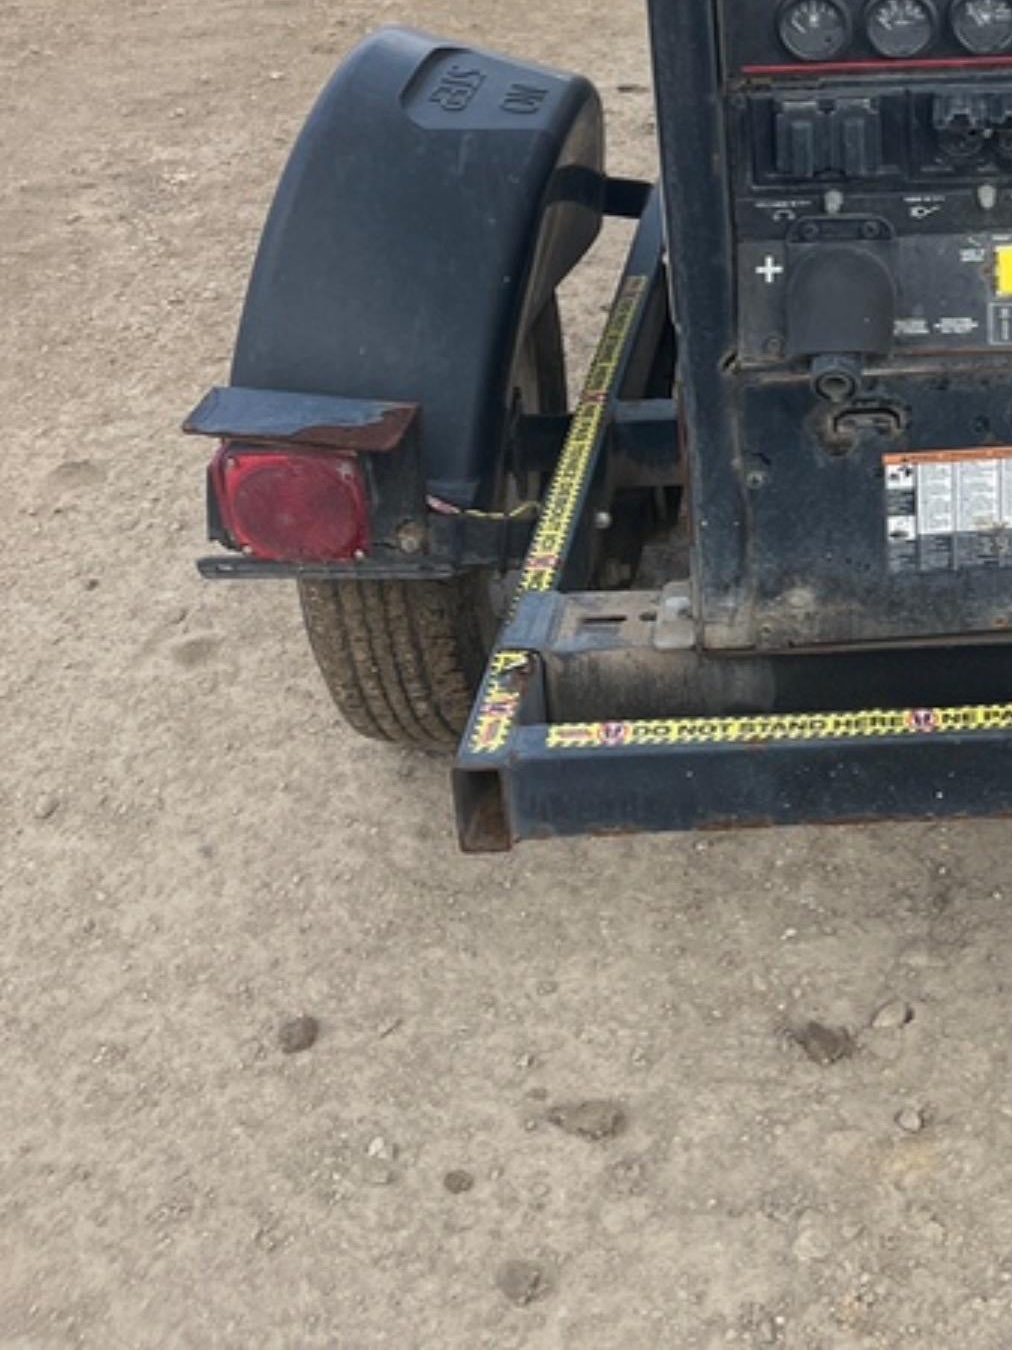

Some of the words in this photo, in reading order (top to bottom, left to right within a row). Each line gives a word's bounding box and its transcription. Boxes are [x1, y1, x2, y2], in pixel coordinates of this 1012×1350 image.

[632, 724, 672, 737] DO
[678, 722, 732, 736] NOT
[738, 719, 826, 734] STAND
[834, 715, 905, 730] HERE
